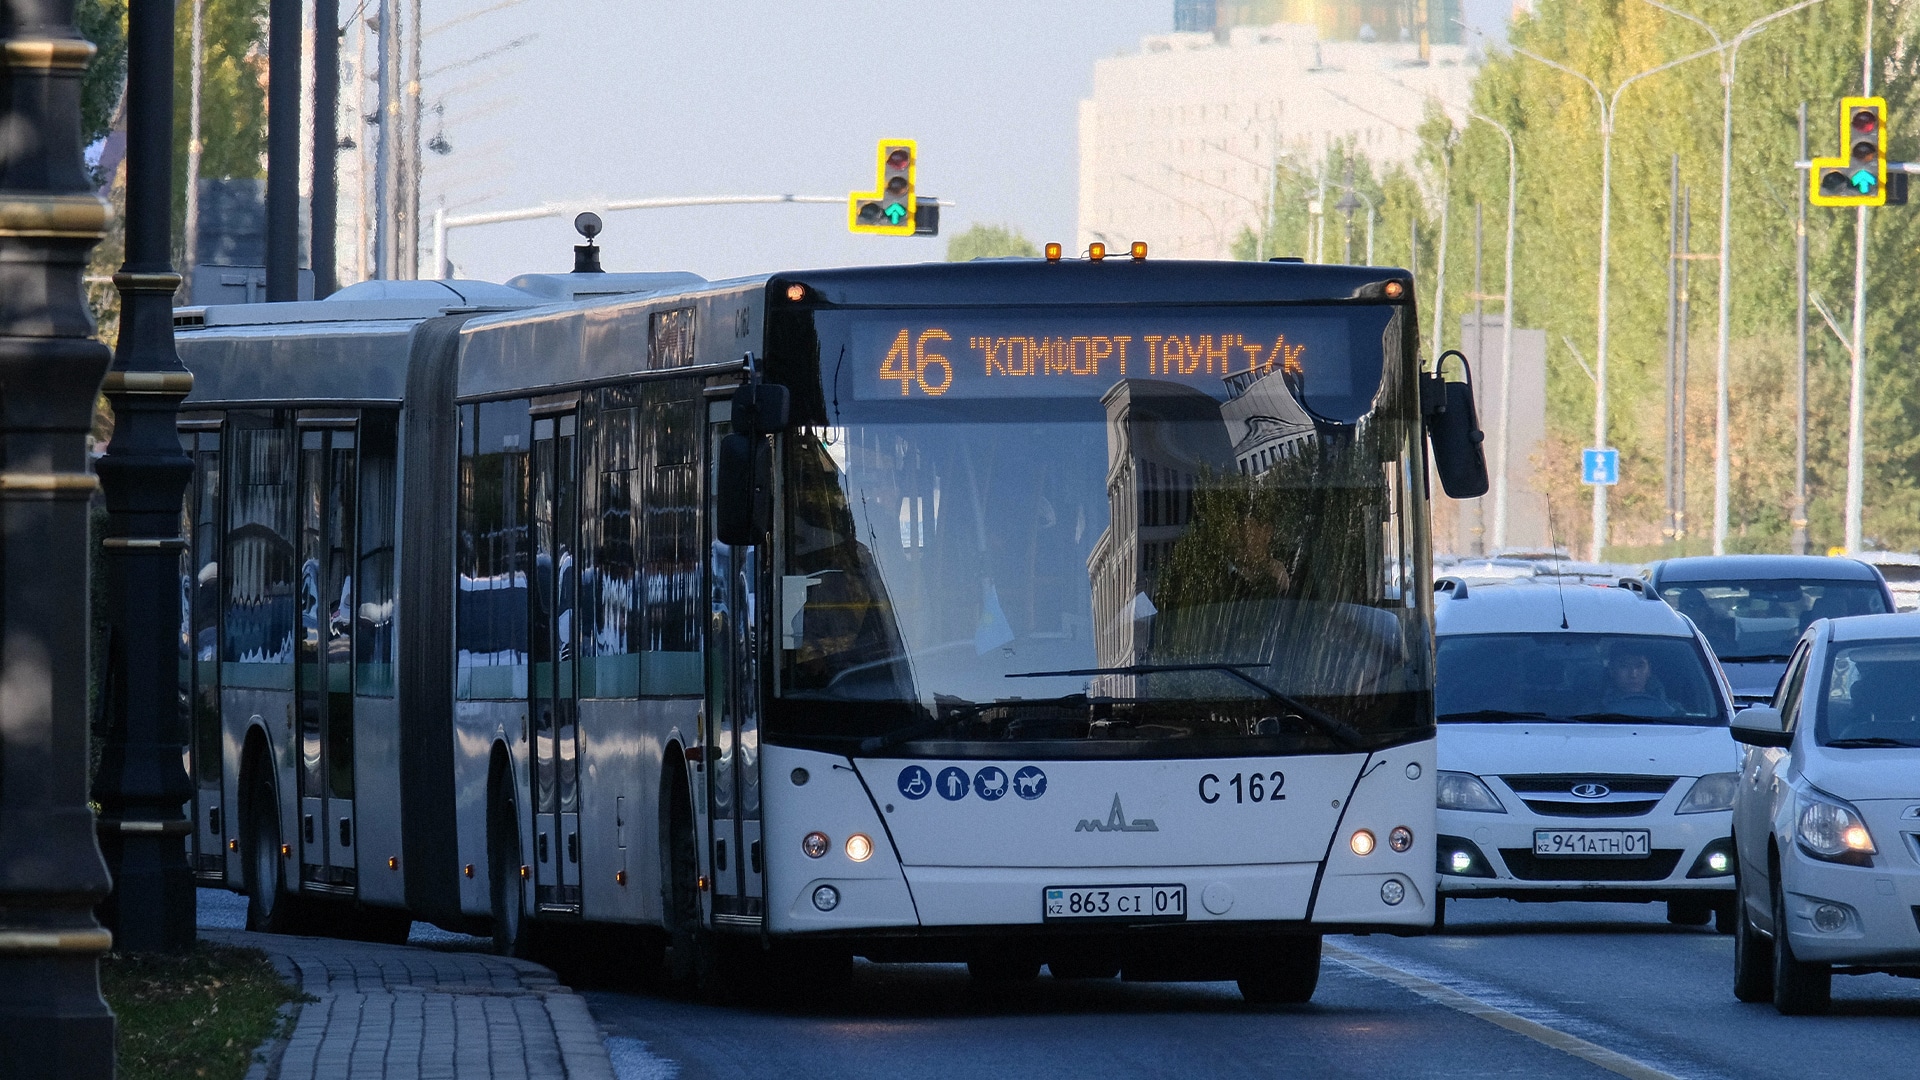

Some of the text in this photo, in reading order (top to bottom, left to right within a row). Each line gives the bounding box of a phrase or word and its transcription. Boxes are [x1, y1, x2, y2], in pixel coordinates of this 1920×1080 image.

[879, 328, 953, 396] 46
[1048, 905, 1063, 914] KZ
[1069, 892, 1110, 913] 863
[1155, 890, 1181, 911] 01
